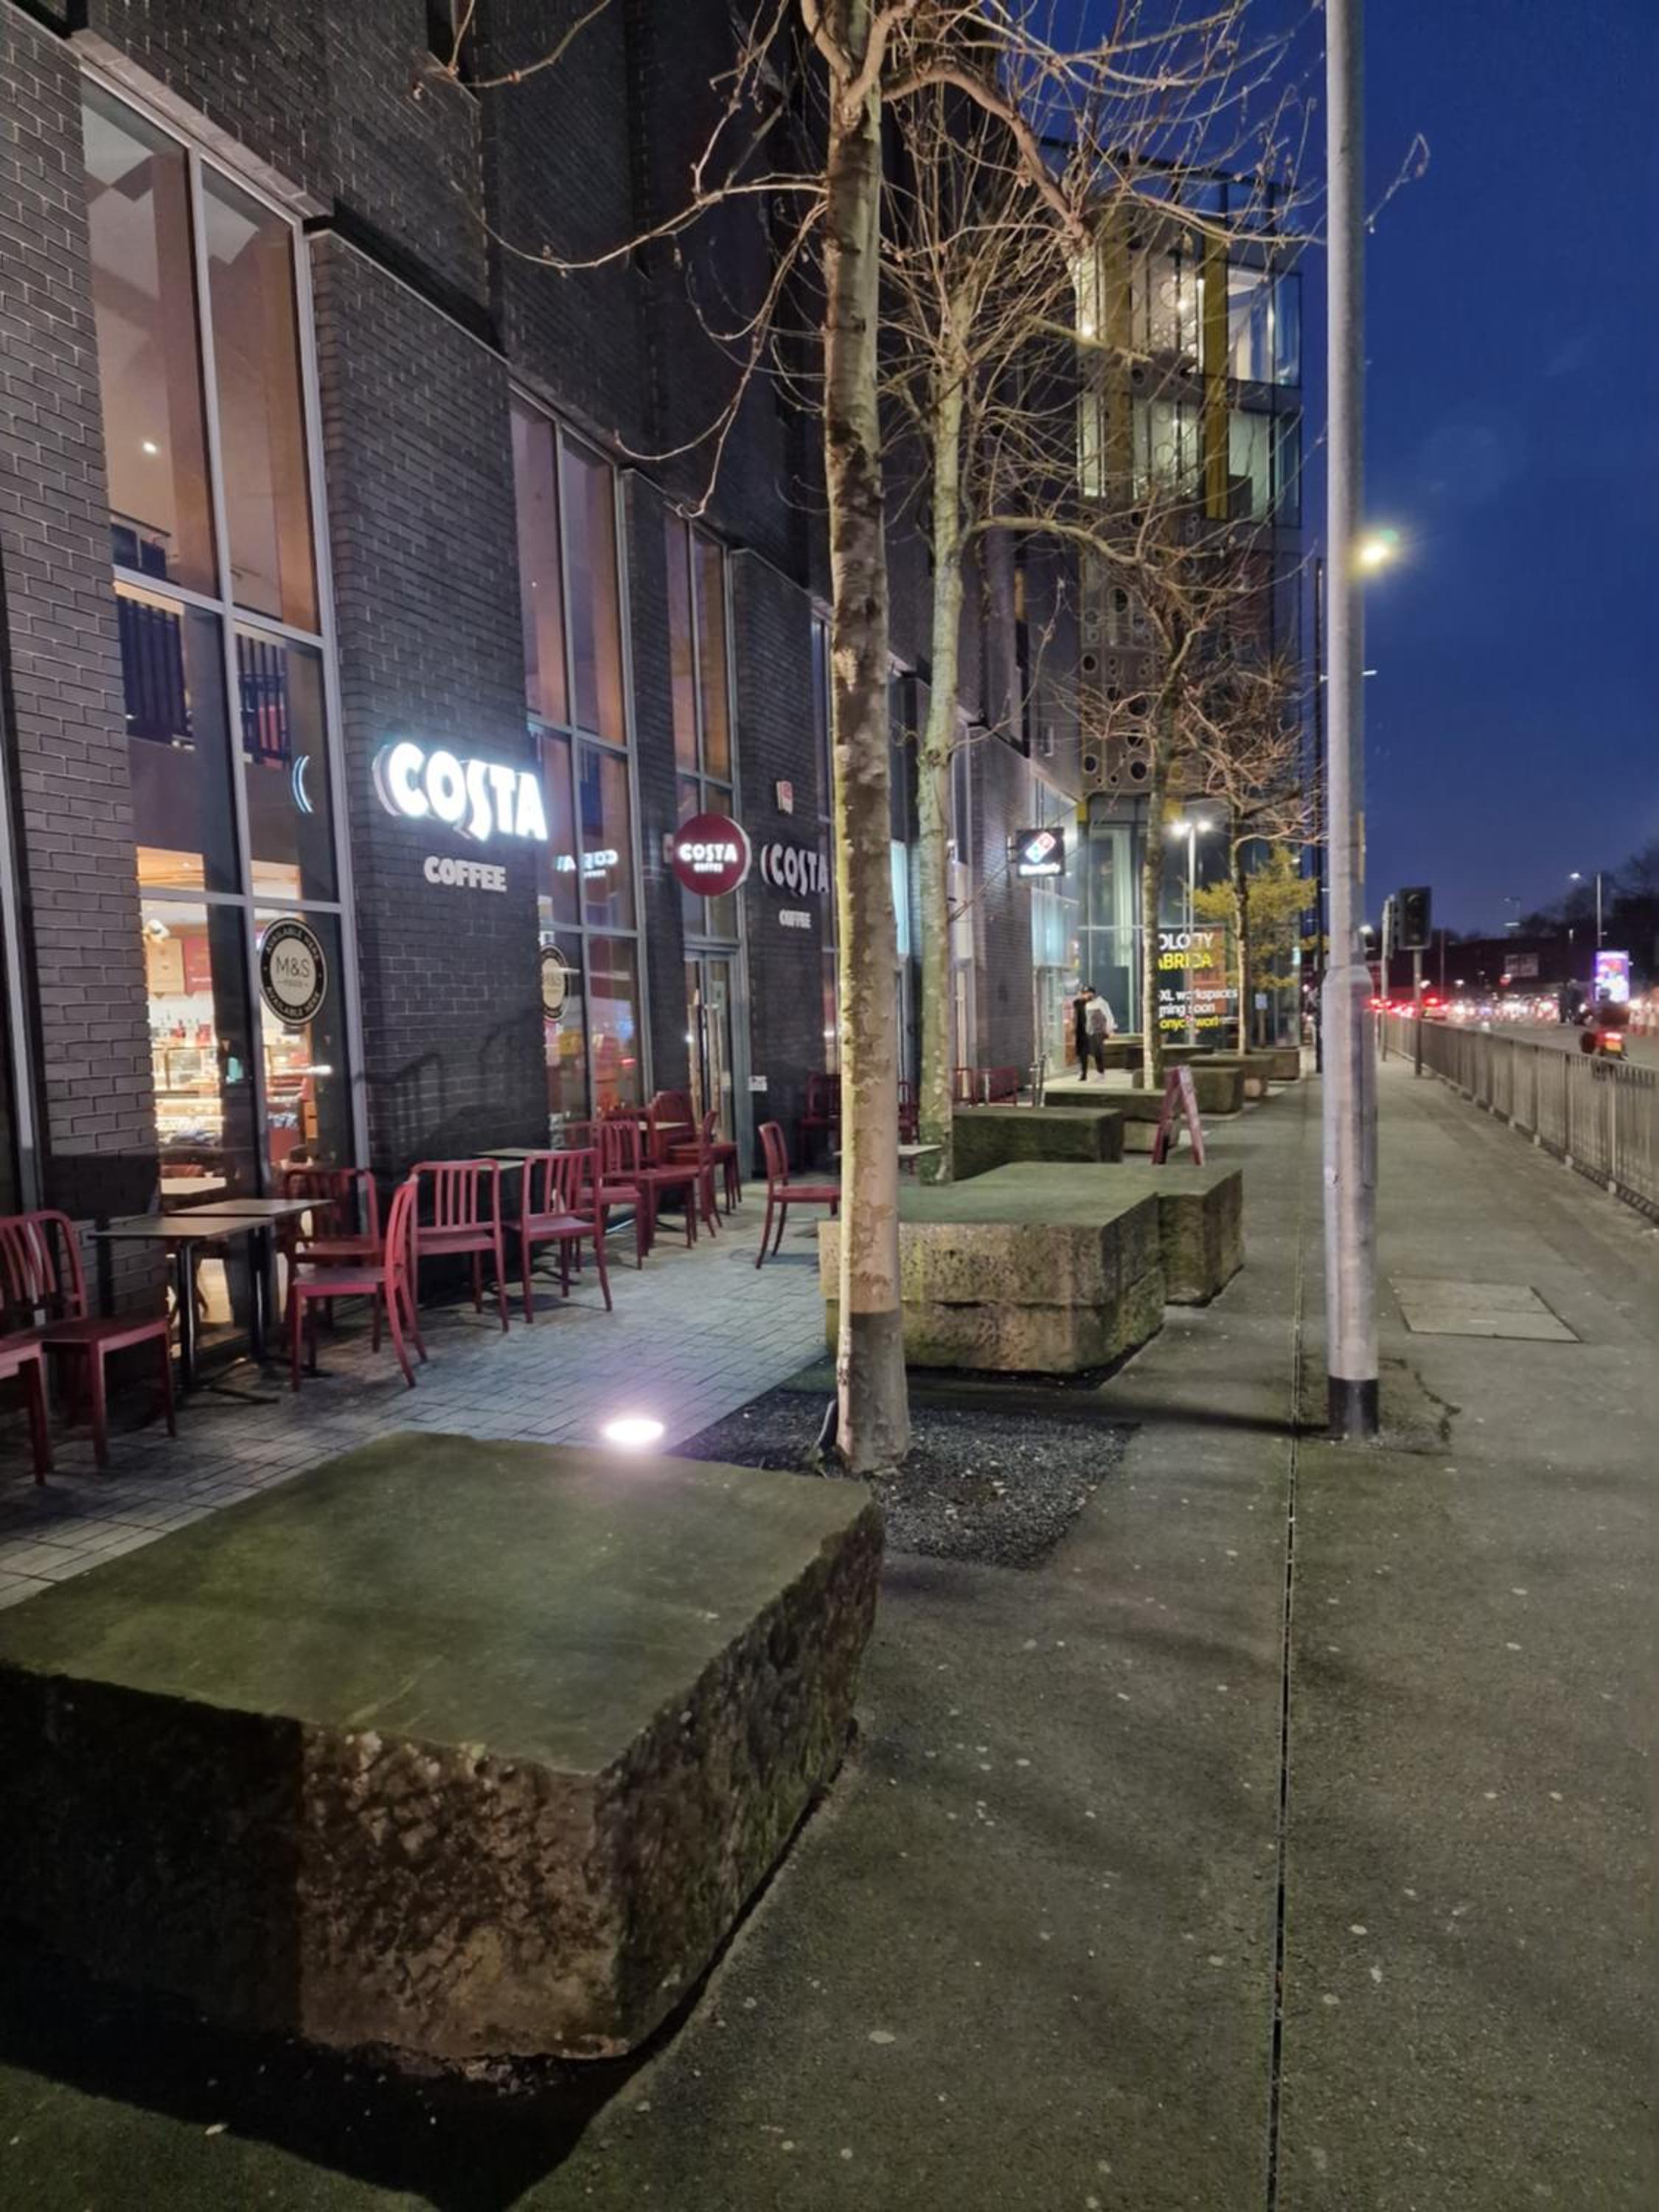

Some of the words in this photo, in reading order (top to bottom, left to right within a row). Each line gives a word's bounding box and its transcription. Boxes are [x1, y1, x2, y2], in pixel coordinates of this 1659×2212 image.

[388, 742, 548, 842] COSTA
[678, 843, 737, 862] COSTA
[771, 844, 830, 897] COSTA
[423, 855, 507, 893] COFFEE
[275, 956, 310, 978] M&S
